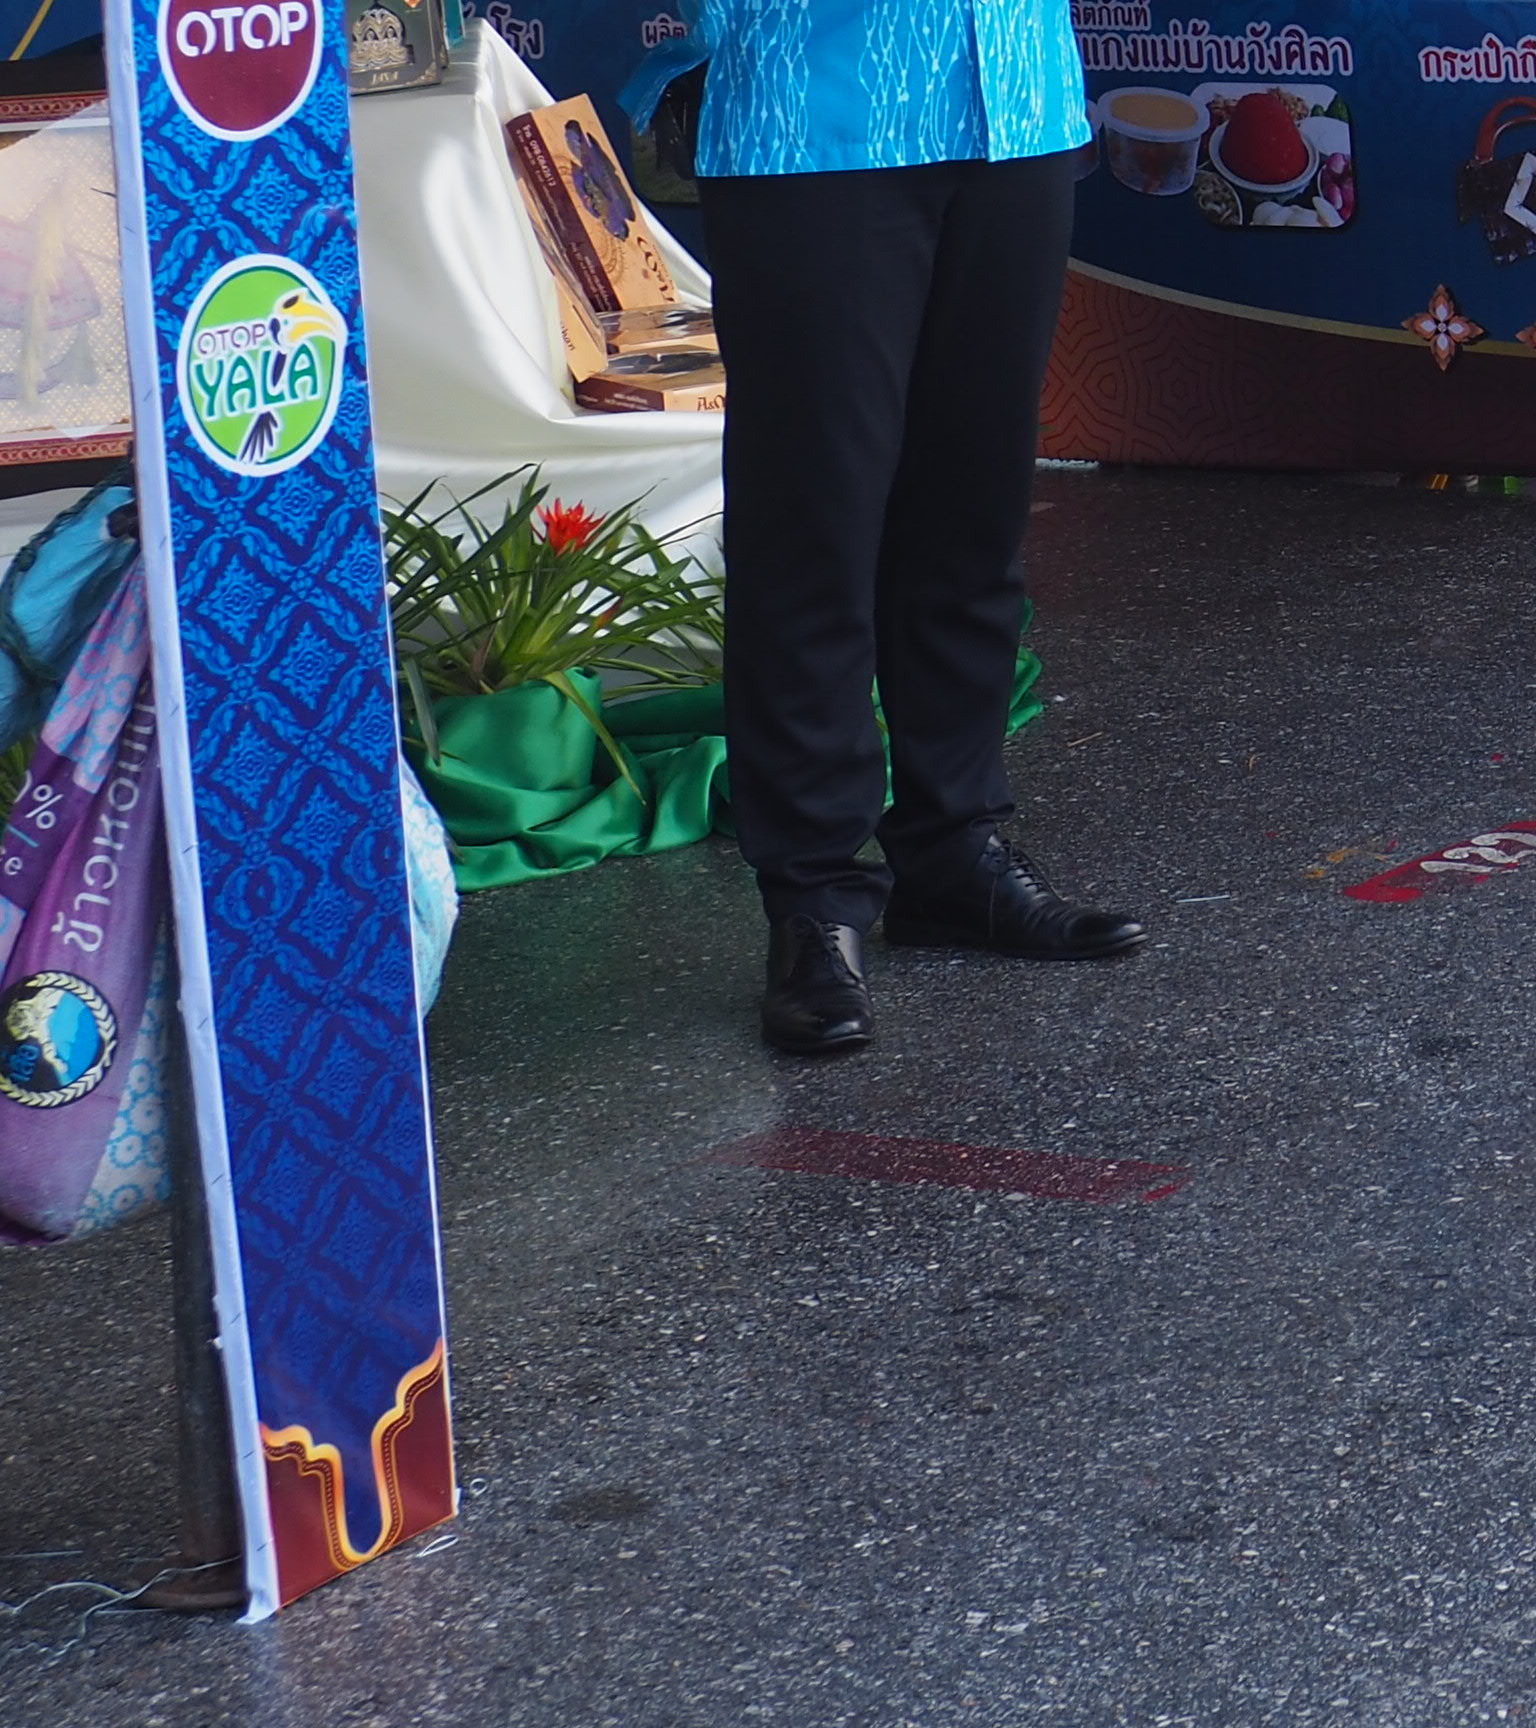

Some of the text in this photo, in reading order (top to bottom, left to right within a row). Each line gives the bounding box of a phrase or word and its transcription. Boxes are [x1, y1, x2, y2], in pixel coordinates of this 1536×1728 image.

[175, 0, 308, 58] OTOP
[196, 323, 266, 358] OTOP
[195, 346, 319, 420] YALA
